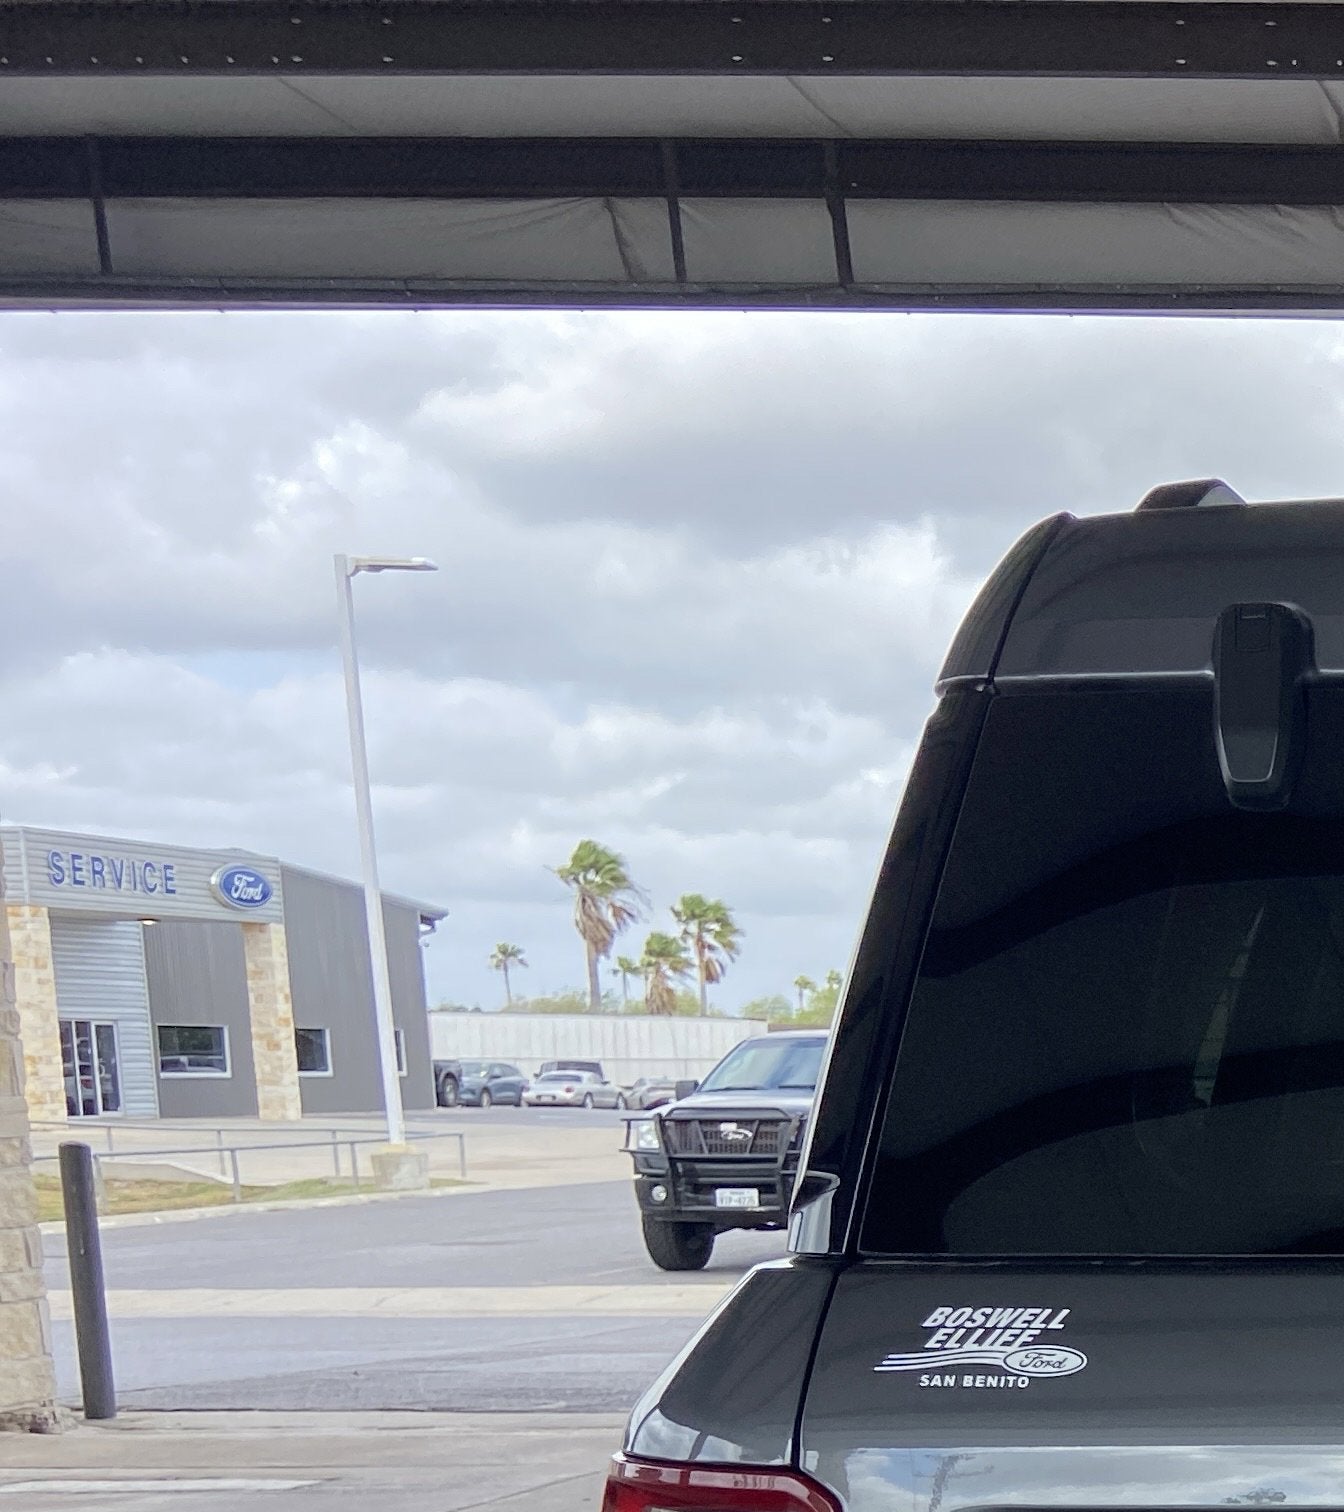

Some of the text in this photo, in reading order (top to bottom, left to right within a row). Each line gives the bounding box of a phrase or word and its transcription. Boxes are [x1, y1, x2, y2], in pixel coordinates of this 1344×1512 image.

[48, 849, 177, 896] SERVICE
[231, 873, 264, 902] Ford
[921, 1306, 1071, 1330] BOSWELL
[924, 1328, 1042, 1349] ELLIFF
[1018, 1351, 1068, 1371] Ford
[919, 1375, 1030, 1389] SAN BENITO
